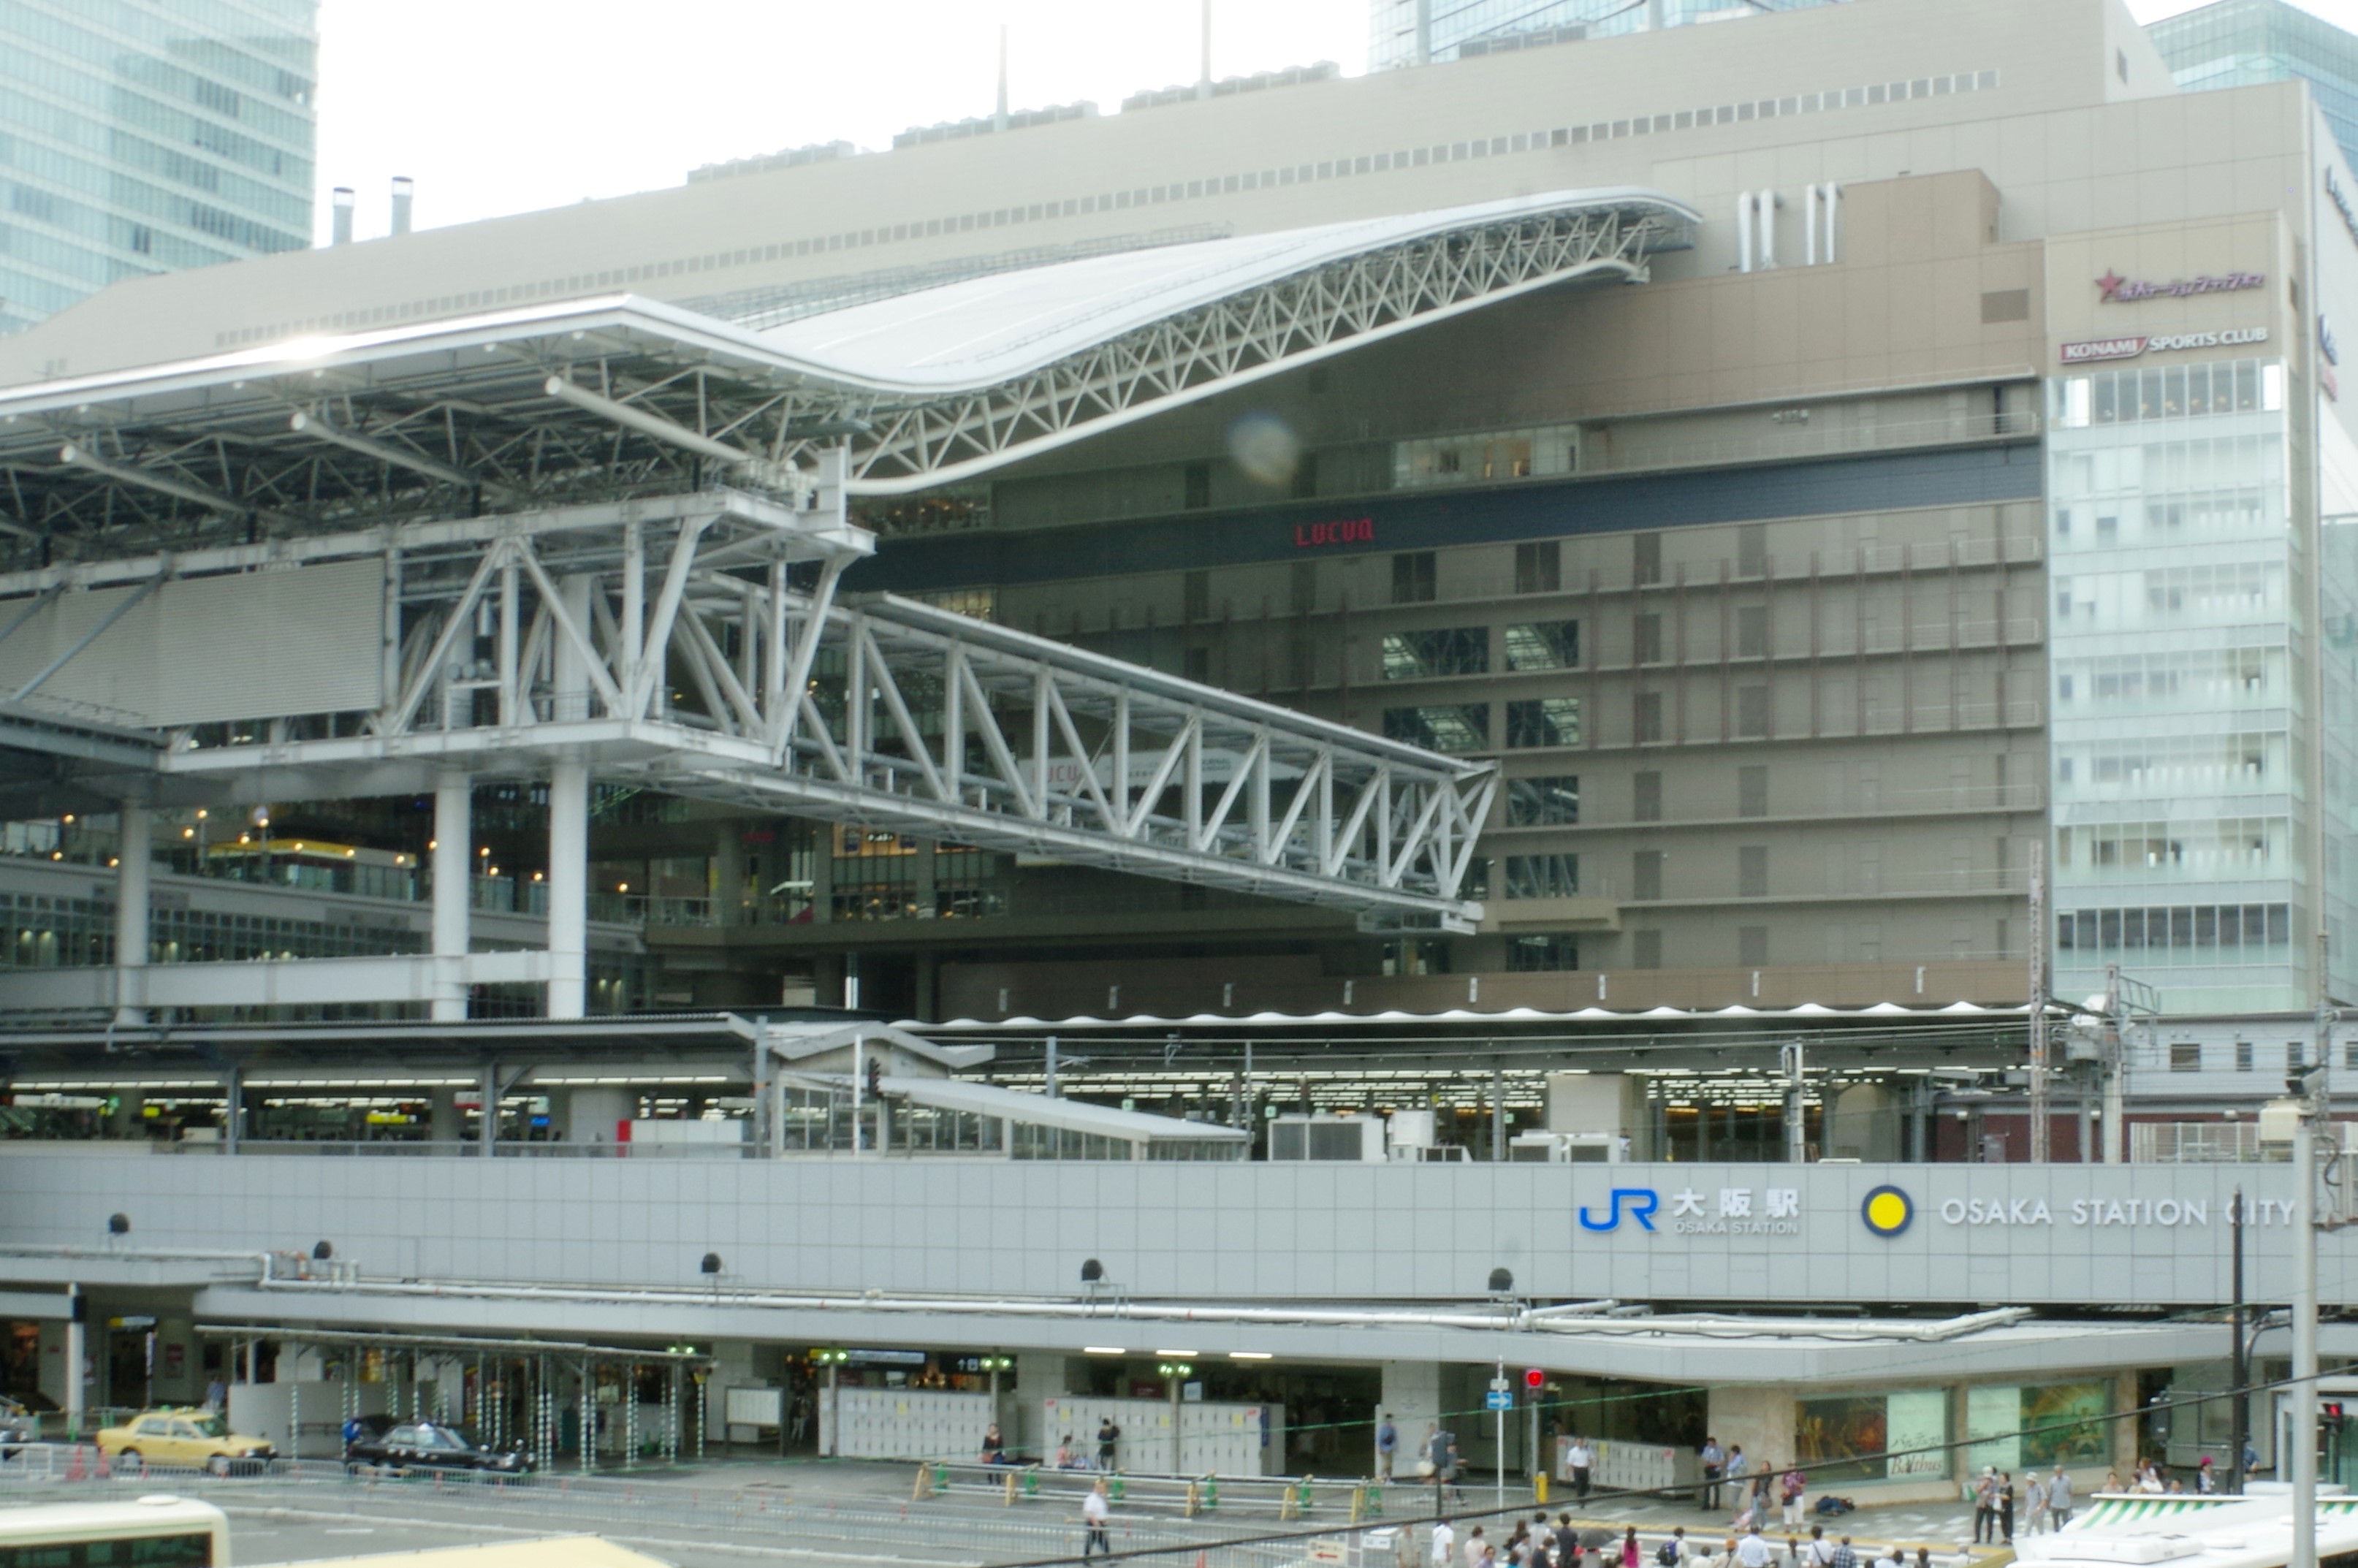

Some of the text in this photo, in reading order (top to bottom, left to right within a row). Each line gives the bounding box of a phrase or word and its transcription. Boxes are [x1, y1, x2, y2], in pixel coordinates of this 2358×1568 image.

[2065, 327, 2269, 359] KONAMI SPORTS CLUB
[1580, 1188, 1659, 1232] JR
[1672, 1187, 1800, 1218] 大阪駅
[1940, 1198, 2053, 1225] OSAKA
[2072, 1198, 2208, 1226] STATION
[1732, 1221, 1799, 1234] STATION
